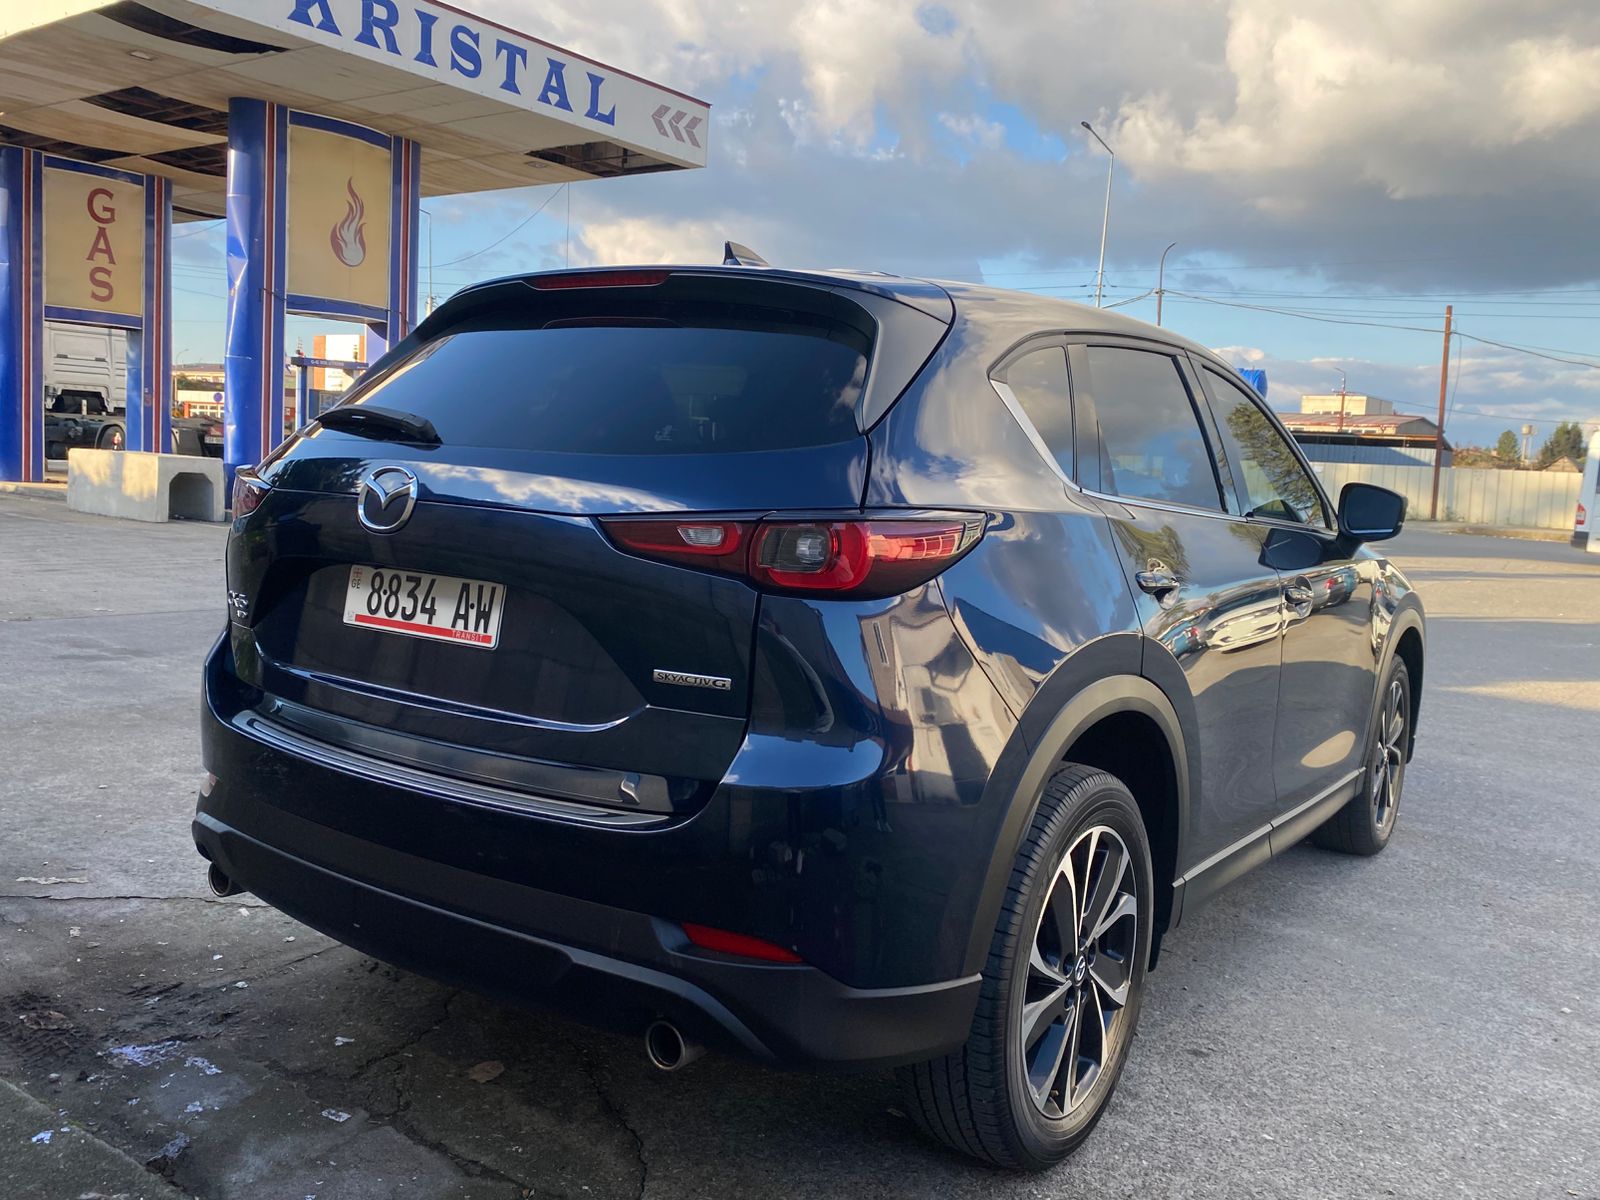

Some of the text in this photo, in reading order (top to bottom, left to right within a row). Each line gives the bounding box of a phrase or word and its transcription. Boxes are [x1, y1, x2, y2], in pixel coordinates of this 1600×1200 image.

[86, 187, 116, 302] GAS
[351, 578, 361, 589] GE
[367, 571, 437, 625] 8834
[451, 629, 484, 643] TRANSIT
